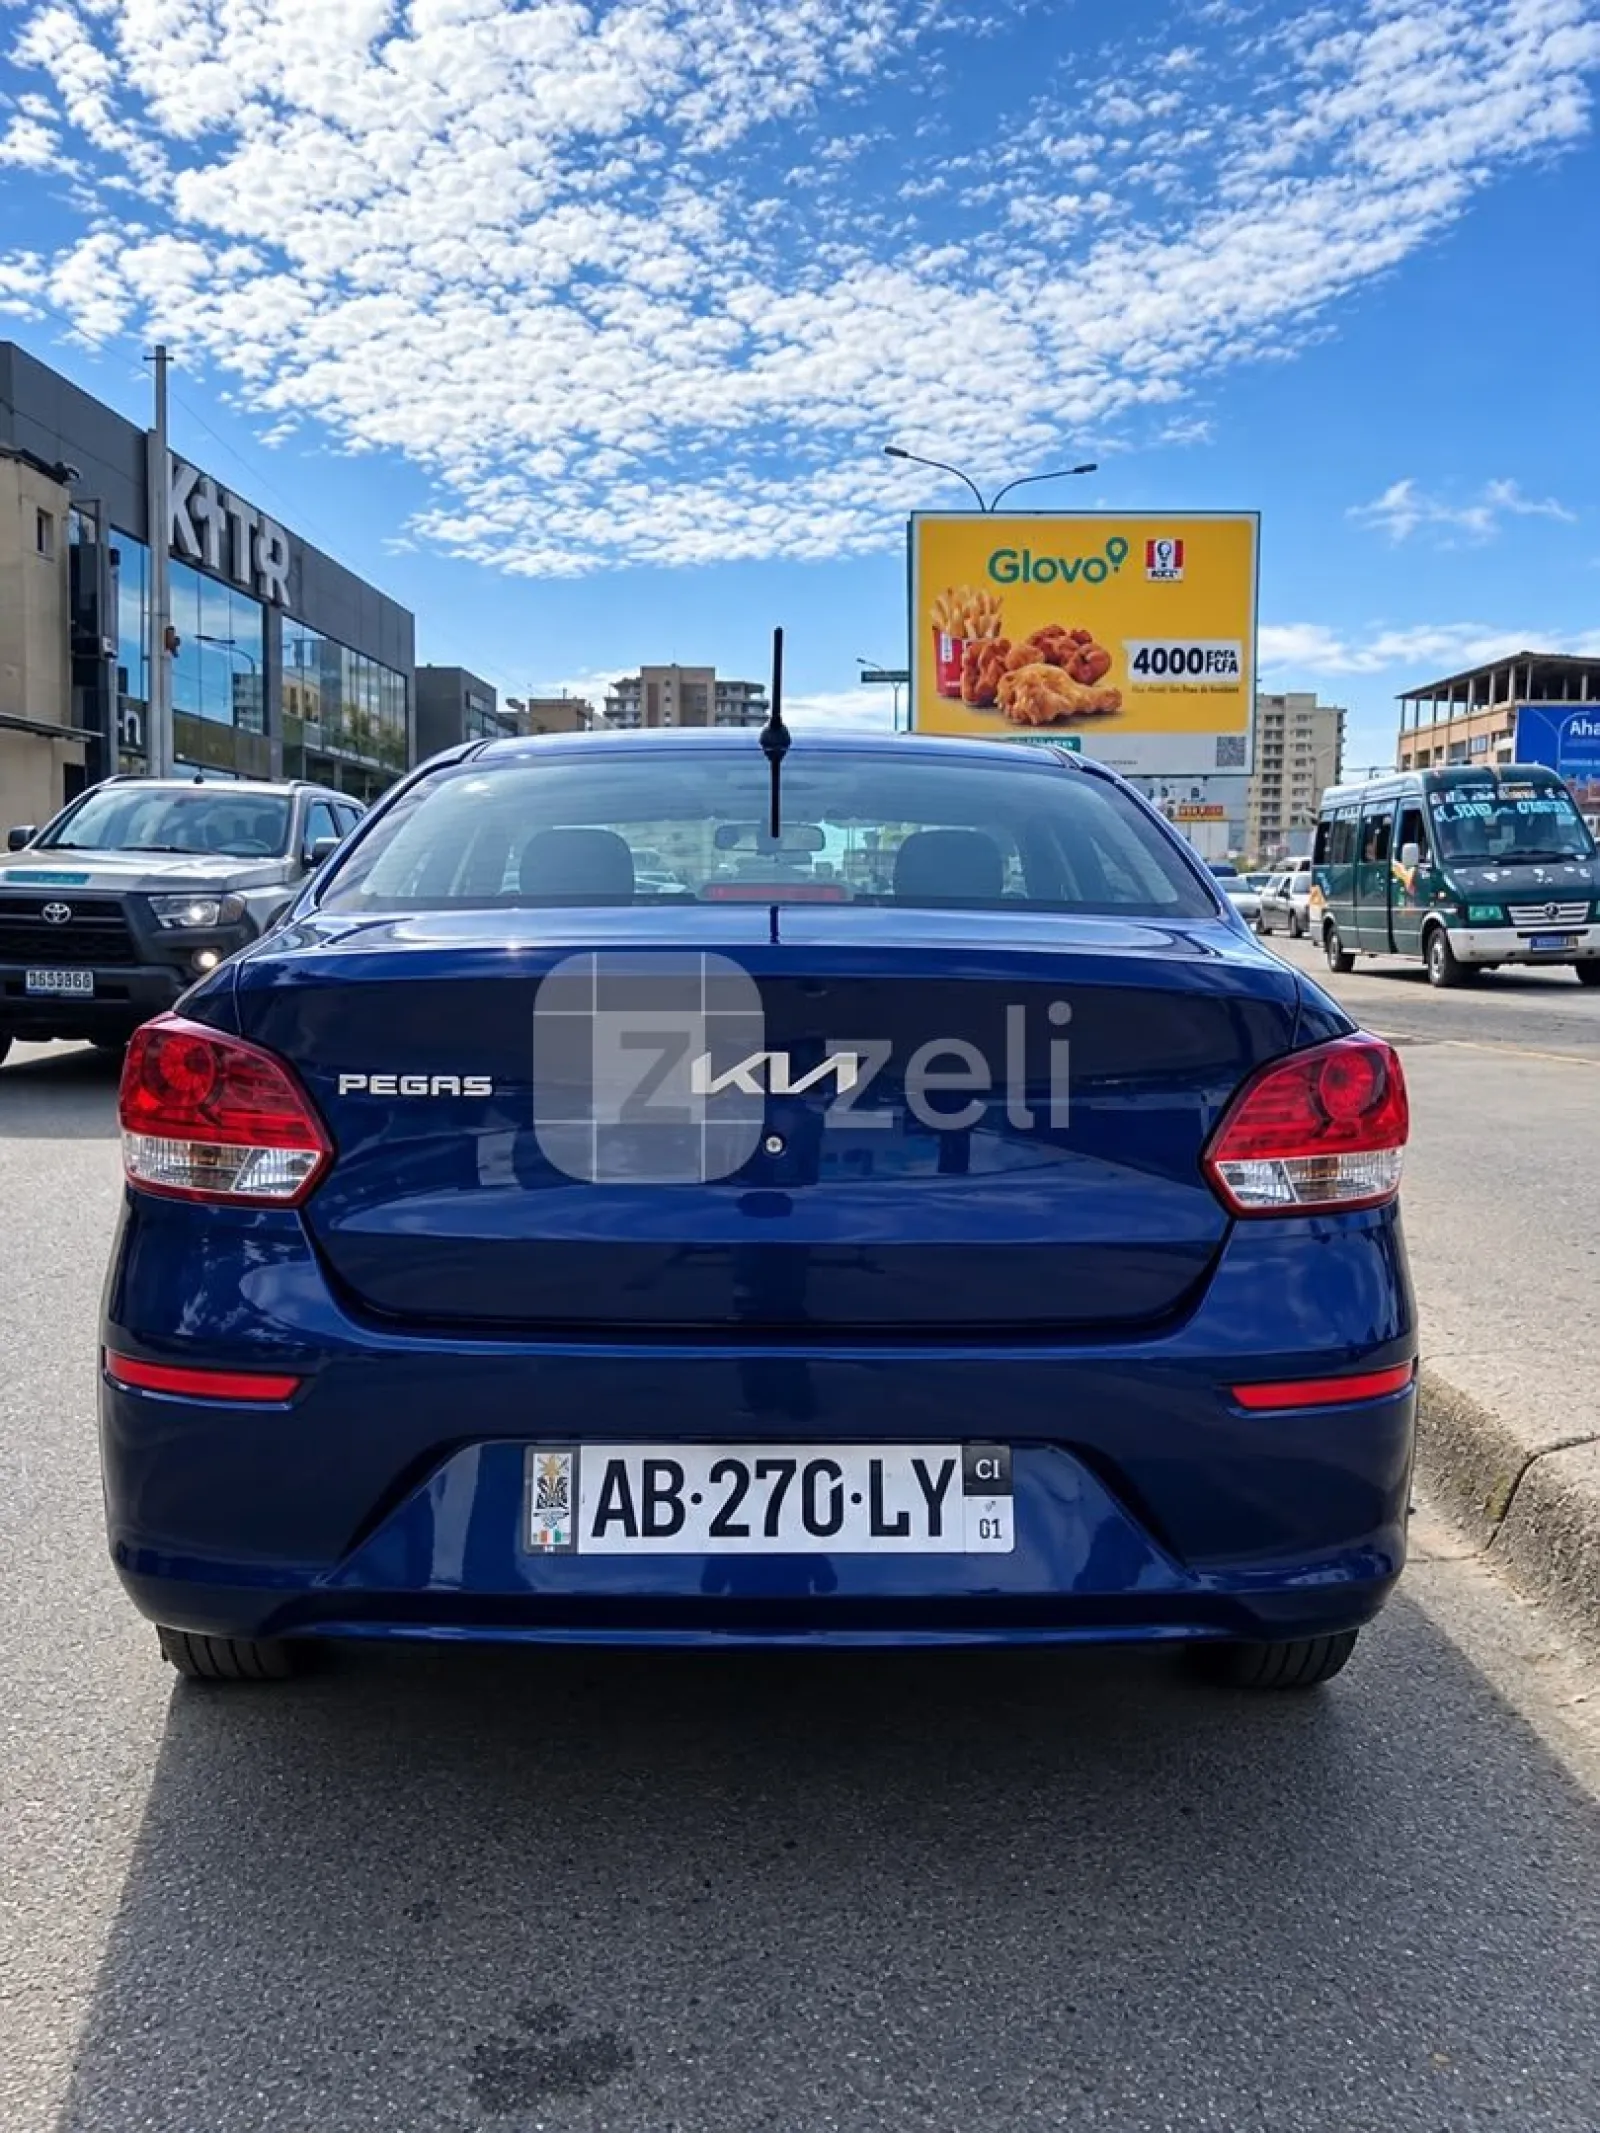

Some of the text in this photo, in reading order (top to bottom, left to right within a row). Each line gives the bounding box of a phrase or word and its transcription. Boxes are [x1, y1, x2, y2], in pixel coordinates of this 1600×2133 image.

[988, 548, 1108, 584] Glovo
[1133, 647, 1203, 674] 4000
[338, 1074, 493, 1097] PEGAS
[976, 1459, 1000, 1479] CI
